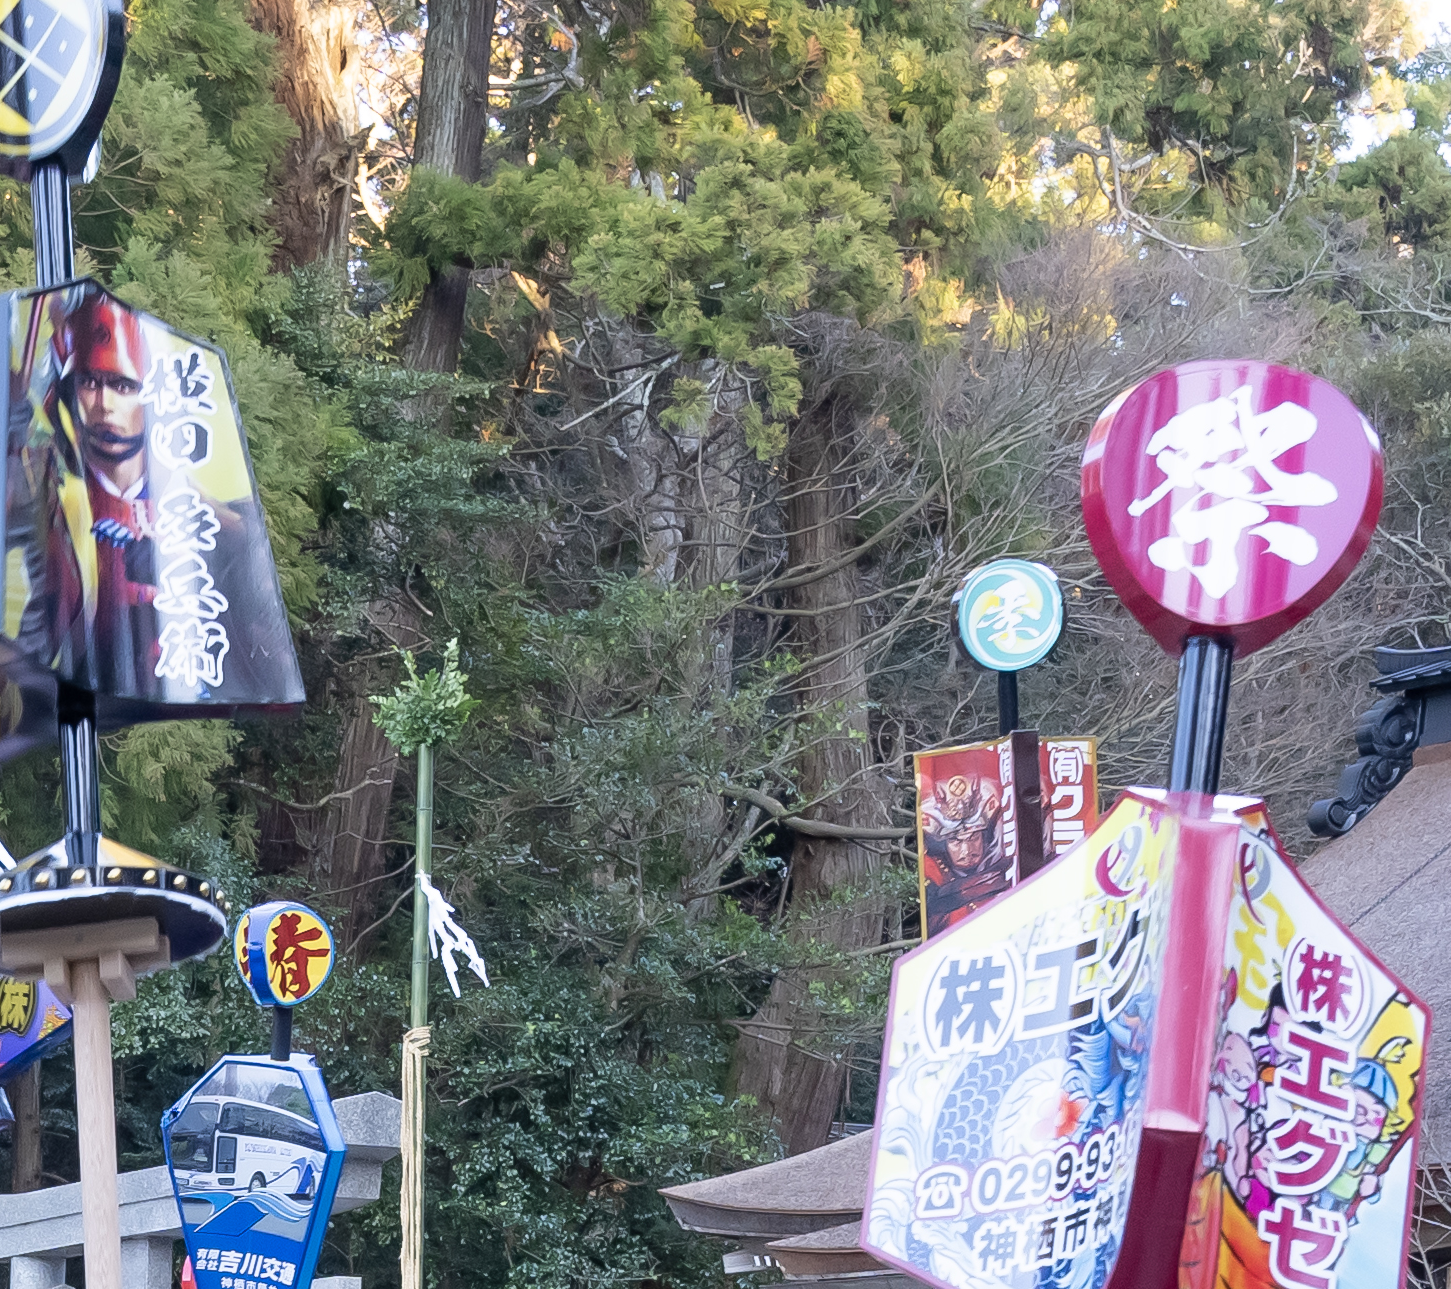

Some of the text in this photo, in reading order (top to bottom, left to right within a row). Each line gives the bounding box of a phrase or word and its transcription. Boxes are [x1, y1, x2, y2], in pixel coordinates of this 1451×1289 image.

[1128, 384, 1338, 599] 祭
[270, 913, 330, 999] 春
[219, 1250, 296, 1286] 吉川交通
